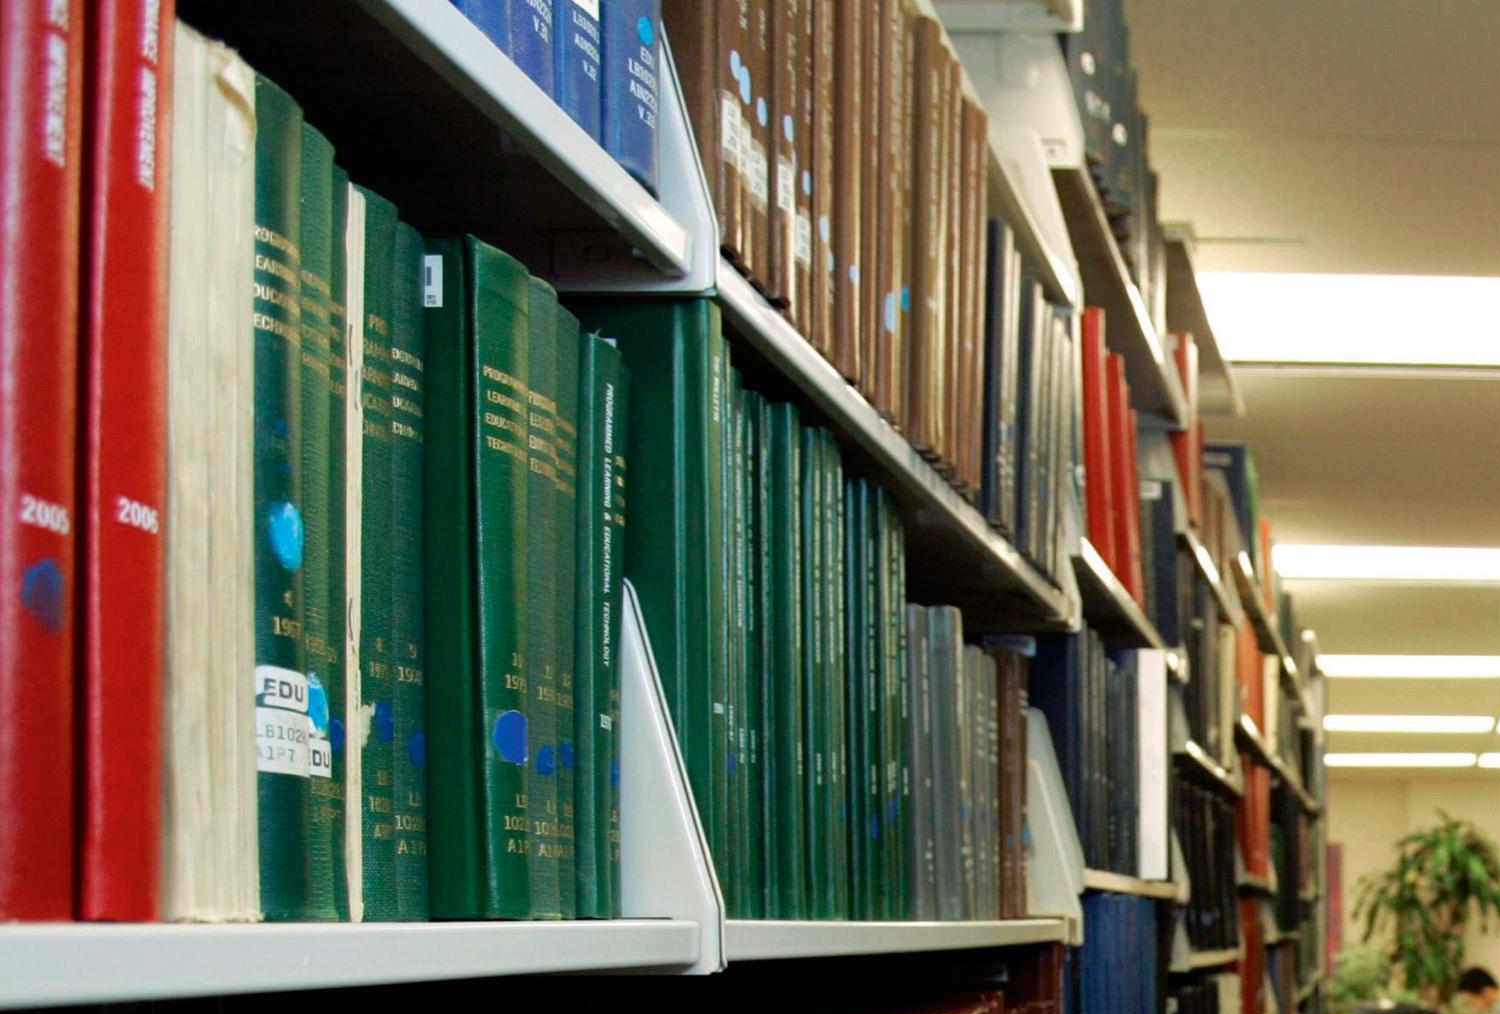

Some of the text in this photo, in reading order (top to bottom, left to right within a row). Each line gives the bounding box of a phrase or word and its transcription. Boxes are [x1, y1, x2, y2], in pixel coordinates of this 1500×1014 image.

[20, 496, 70, 535] 2005
[117, 496, 159, 534] 2006
[264, 678, 304, 703] EDU
[309, 749, 330, 768] DU
